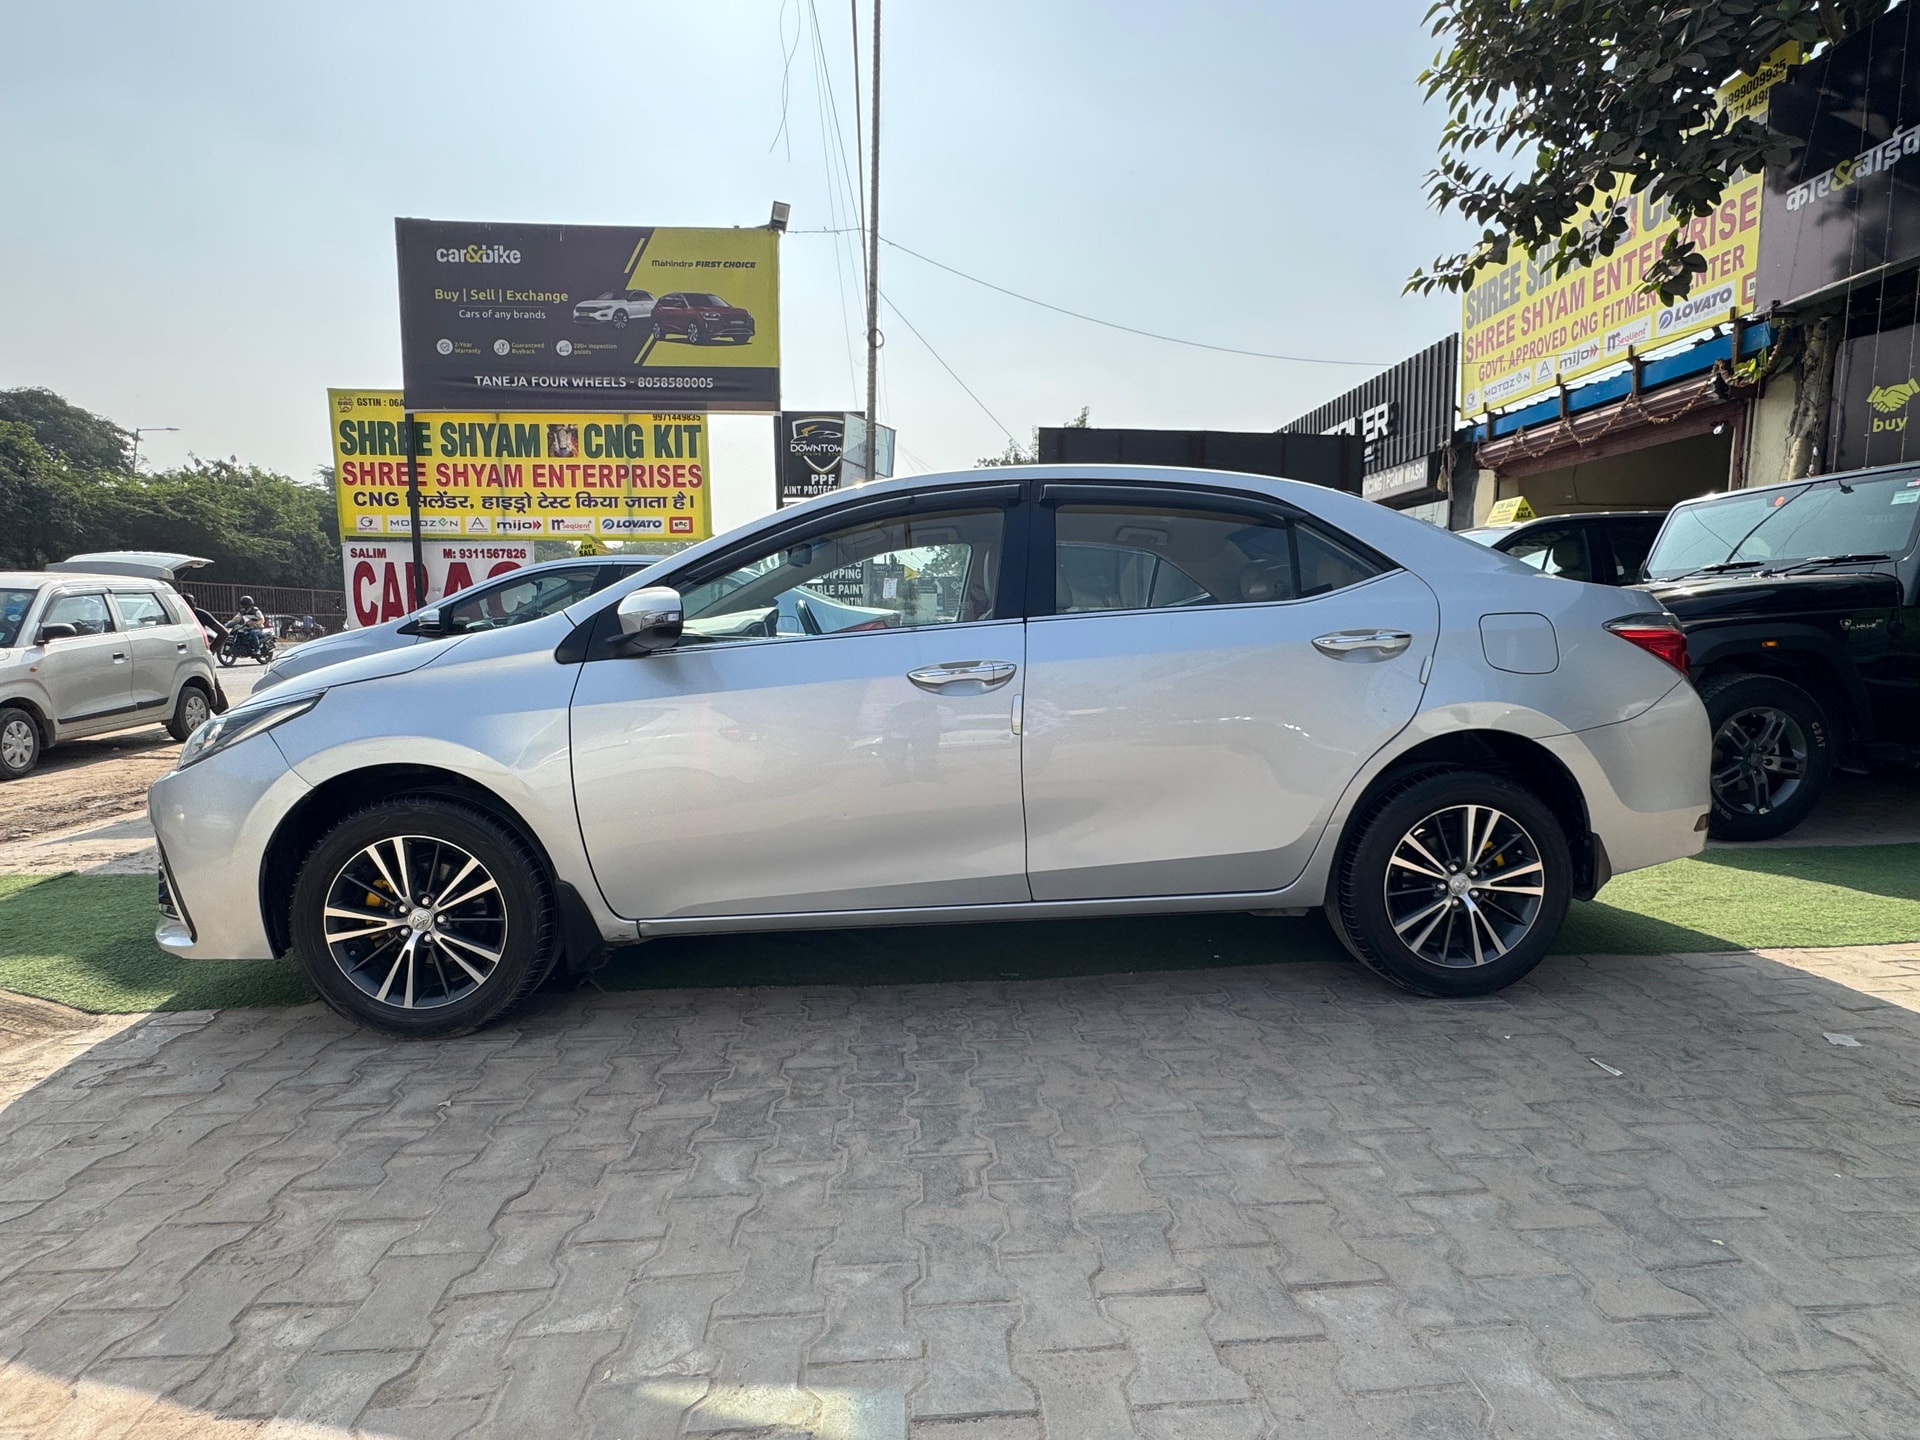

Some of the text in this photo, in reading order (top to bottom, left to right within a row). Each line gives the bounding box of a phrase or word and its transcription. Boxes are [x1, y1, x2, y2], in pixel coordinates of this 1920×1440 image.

[436, 244, 521, 264] car&bike
[652, 259, 756, 269] Mahindra FIRST CHOICE
[434, 289, 459, 302] Buy
[470, 289, 495, 301] Sell
[506, 290, 568, 303] Exchange
[1466, 260, 1521, 330] SHREE
[1674, 288, 1732, 321] LOVATO
[458, 309, 546, 320] Cars of any brands
[1466, 314, 1515, 364] SHREE
[1521, 276, 1585, 336] SHYAM
[1479, 355, 1506, 382] GOVT.
[1508, 326, 1567, 370] APPROVED
[1571, 311, 1598, 341] CNG
[1603, 291, 1656, 328] FITMEN
[474, 375, 528, 387] TANEJA
[531, 376, 568, 387] FOUR
[571, 376, 626, 387] WHEELS
[637, 377, 714, 388] 8058580005
[356, 397, 381, 407] GSTIN
[1872, 416, 1908, 433] buy
[339, 419, 701, 459] SHREE SHYAM CNG KIT
[790, 443, 842, 453] DOWNTOW
[342, 461, 703, 489] SHREE SHYAM ENTERPRISES
[811, 474, 836, 485] PPF
[784, 485, 839, 495] AINT PROTECT
[353, 491, 399, 507] CNG
[481, 491, 532, 514] हाइड्रो
[537, 491, 571, 509] टेस्ट
[575, 491, 619, 509] किया
[625, 496, 667, 509] जाता
[497, 521, 532, 531] mijo
[615, 519, 662, 528] LOVATO
[350, 547, 527, 559] SALIM M: 9311567826
[579, 549, 597, 557] SALE
[1811, 721, 1826, 748] CEAT
